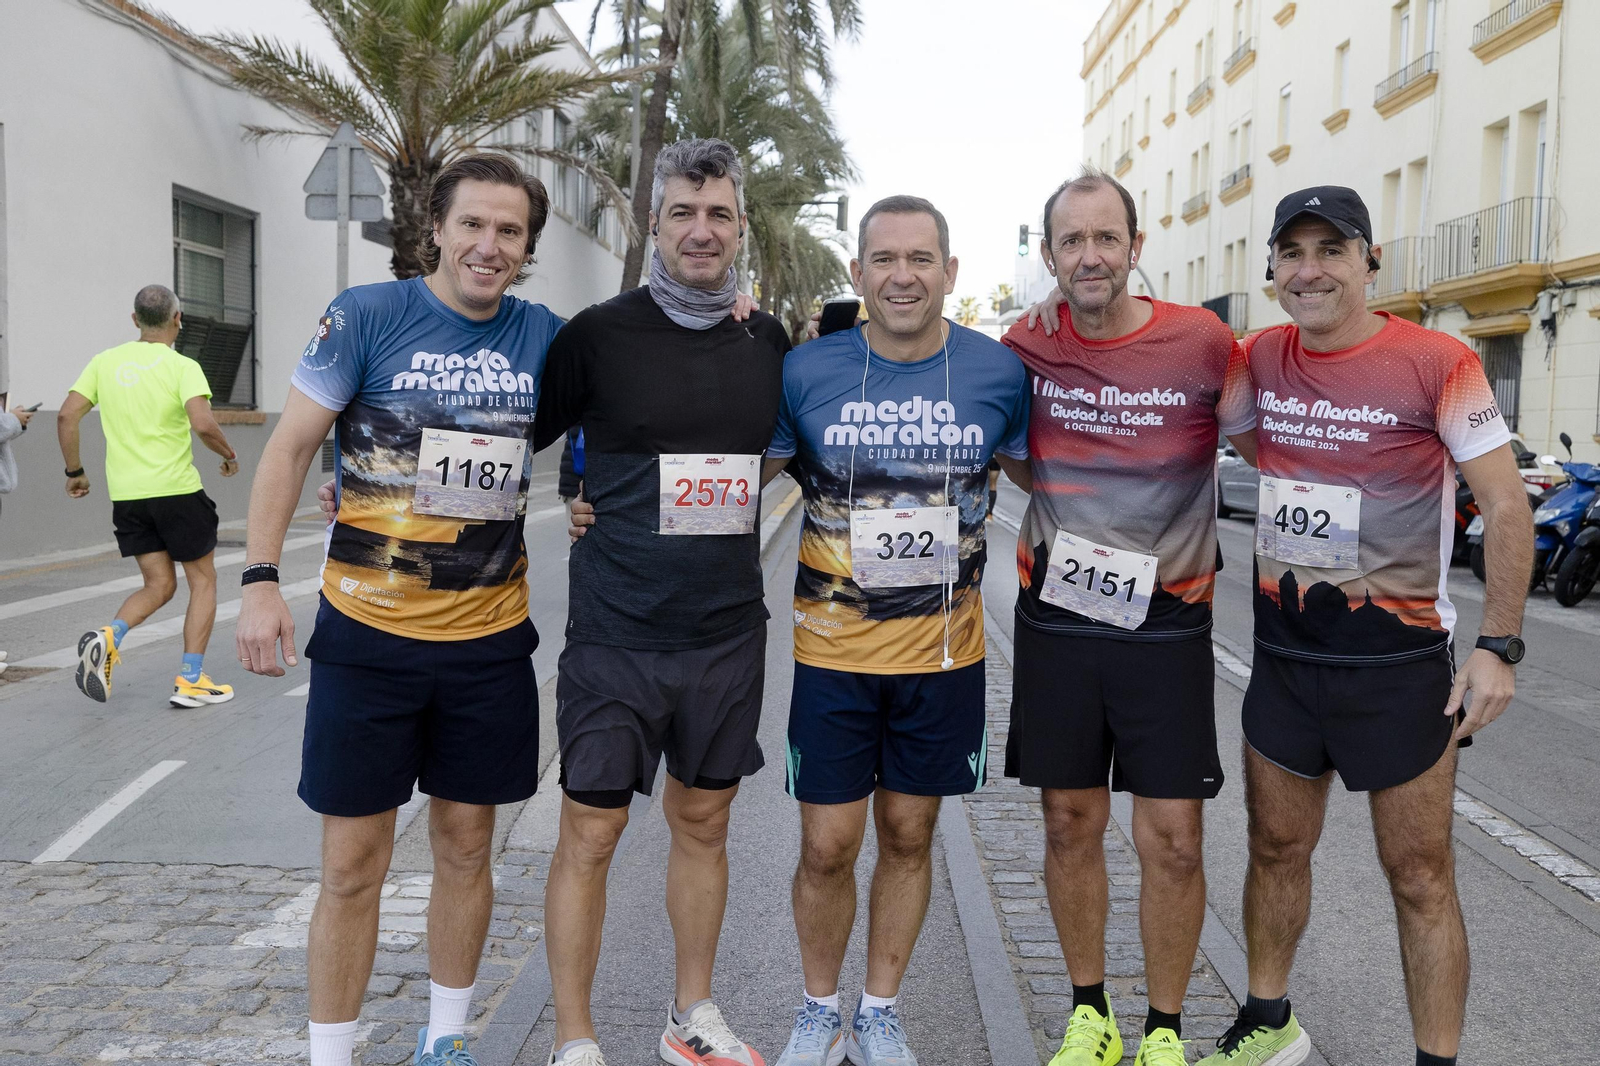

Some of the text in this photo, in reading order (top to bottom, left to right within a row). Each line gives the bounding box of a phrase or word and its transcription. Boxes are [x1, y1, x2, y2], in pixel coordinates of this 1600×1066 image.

[437, 393, 534, 408] CIUDAD DE CÁDIZ
[1042, 379, 1096, 405] Media
[1100, 385, 1186, 406] Maratón
[492, 411, 499, 422] 9
[500, 413, 530, 423] NOVIEMBRE
[840, 395, 955, 422] media
[1050, 402, 1164, 426] Ciudad de Cádiz
[1260, 390, 1308, 417] Media
[1310, 399, 1399, 426] Maratón
[1064, 422, 1138, 437] 6 OCTUBRE 2024
[1262, 415, 1370, 442] Ciudad de Cádiz
[868, 445, 981, 460] CIUDAD DE CÁDIZ
[1271, 434, 1340, 452] 6 OCTUBRE 2024
[435, 456, 513, 492] 1187
[927, 463, 935, 473] 9
[674, 478, 750, 508] 2573
[1274, 504, 1332, 540] 492
[876, 530, 935, 561] 322
[359, 582, 406, 599] Diputación
[1061, 558, 1138, 603] 2151
[370, 596, 396, 609] Cádiz
[806, 613, 843, 630] Diputación
